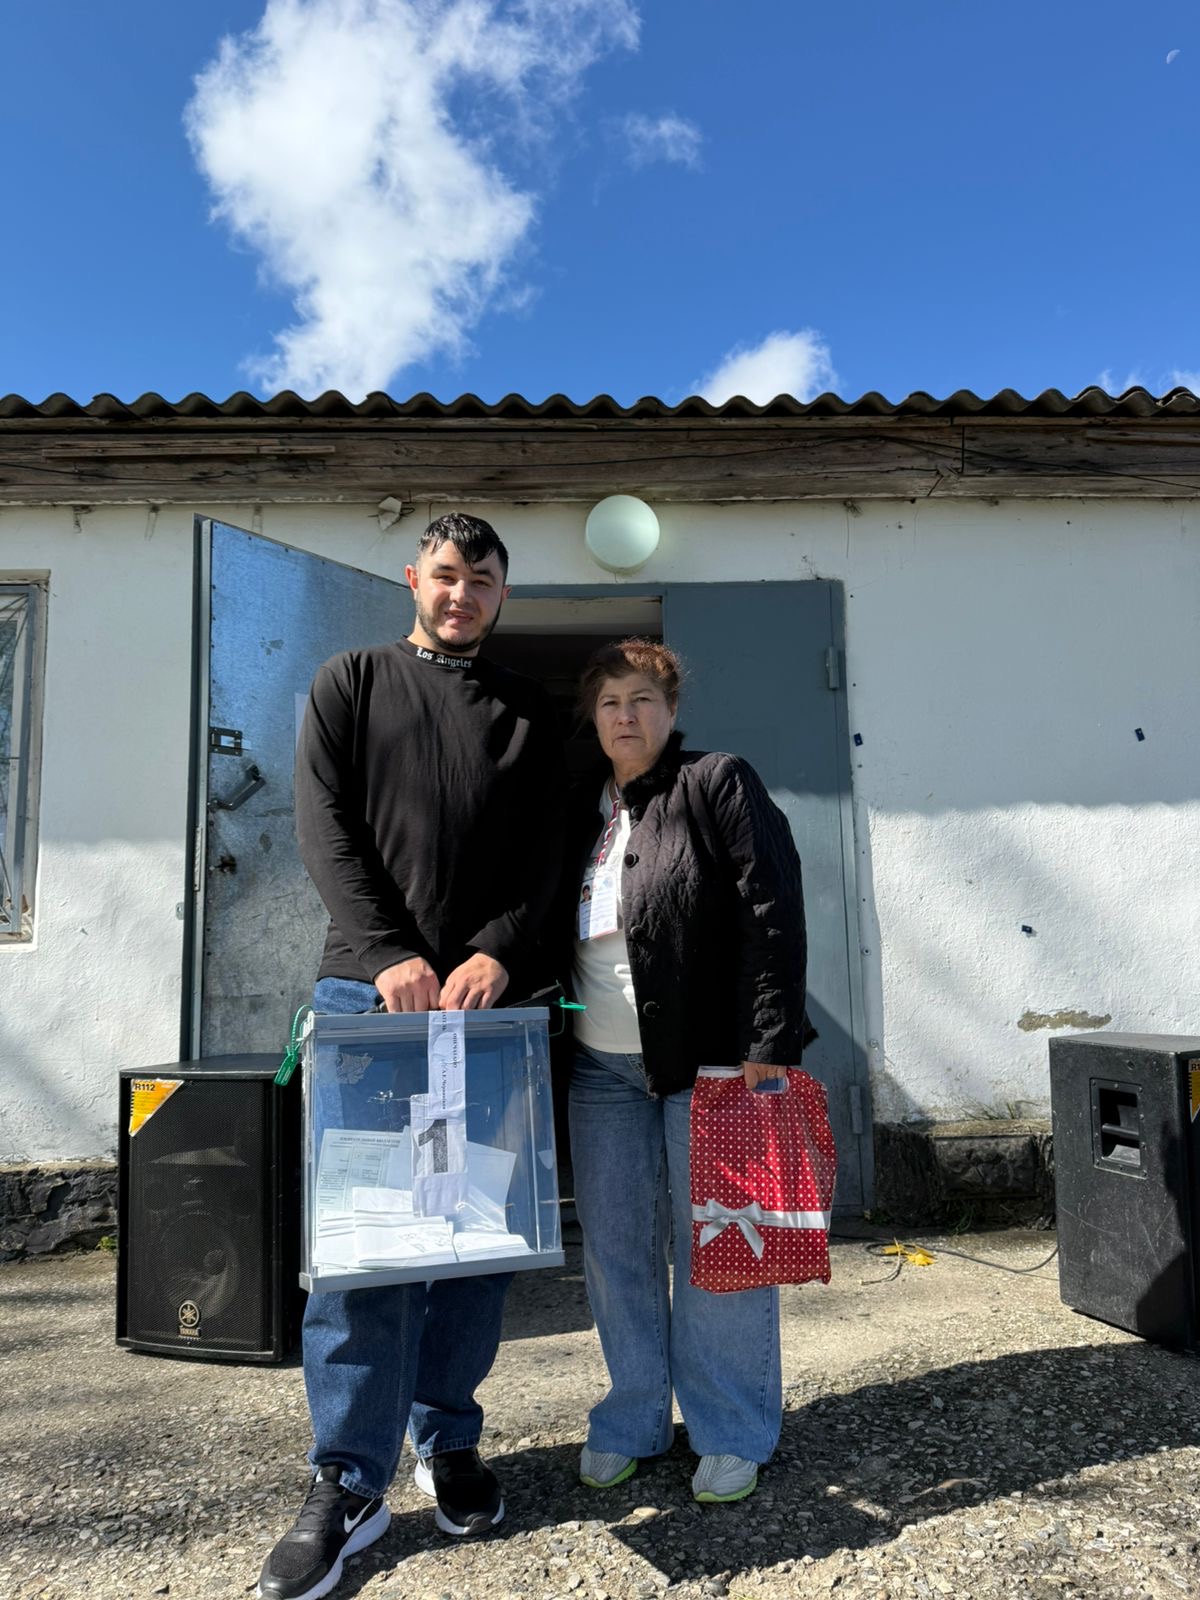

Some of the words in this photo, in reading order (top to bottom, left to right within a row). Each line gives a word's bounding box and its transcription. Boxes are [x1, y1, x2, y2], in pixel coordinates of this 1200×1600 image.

[416, 646, 434, 660] Los
[435, 654, 472, 668] Angeles
[134, 1083, 156, 1091] R112
[418, 1118, 449, 1174] 1
